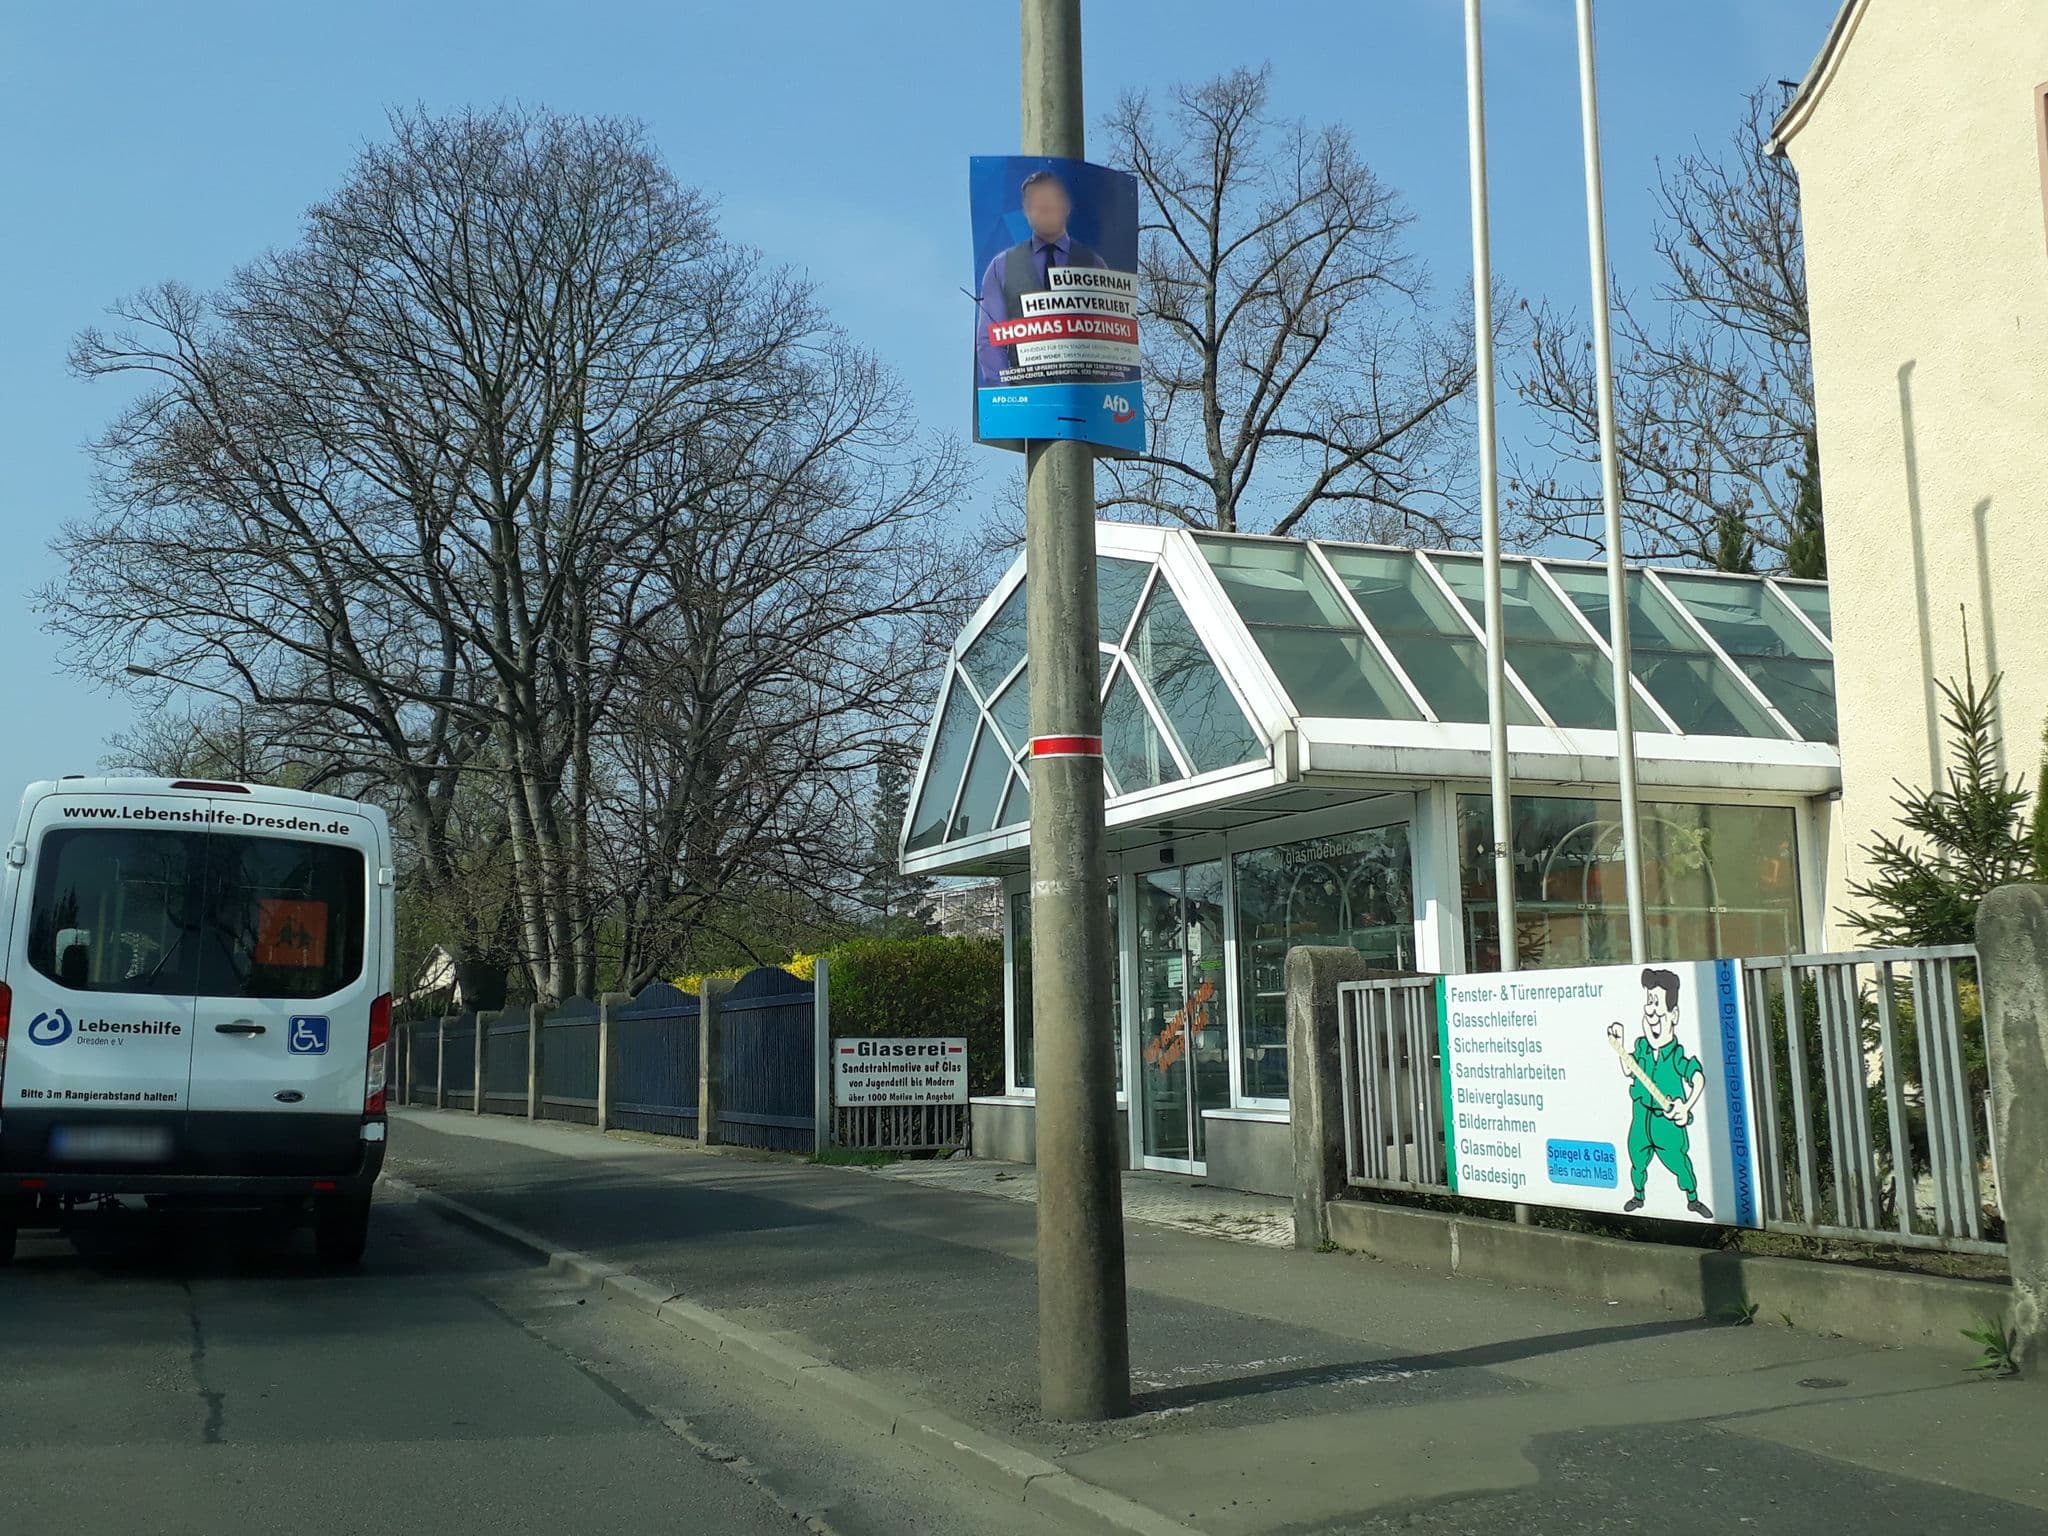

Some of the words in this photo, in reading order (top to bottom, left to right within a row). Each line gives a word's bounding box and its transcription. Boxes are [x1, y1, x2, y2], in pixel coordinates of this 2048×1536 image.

[1053, 271, 1131, 292] BÜRGERNAH
[1026, 296, 1130, 314] HEIMATVERLIEBT
[992, 320, 1064, 341] THOMAS
[1067, 321, 1131, 337] LADZINSKI
[1103, 394, 1129, 413] AfD
[63, 806, 350, 836] www.Lebenshilfe-Dresden.de
[1451, 986, 1497, 1003] Fenster-
[1500, 985, 1509, 1001] &
[1510, 982, 1604, 1003] Türenreparatur
[78, 1019, 181, 1035] Lebenshilfe
[1452, 1010, 1537, 1028] Glasschleiferei
[77, 1036, 109, 1045] Dresden
[858, 1041, 946, 1056] Glaserei
[1454, 1037, 1543, 1057] Sicherheitsglas
[842, 1061, 921, 1074] Sandstrahlmotive
[924, 1061, 940, 1073] auf
[942, 1061, 962, 1073] Glas
[1455, 1062, 1566, 1080] Sandstrahlarbeiten
[849, 1079, 863, 1088] von
[865, 1077, 908, 1090] Jugendstil
[911, 1077, 923, 1087] bis
[925, 1077, 955, 1086] Modern
[1719, 966, 1750, 1215] www.glaserei-herzig.de
[21, 1089, 43, 1099] Bitte
[65, 1090, 141, 1102] Rangierabstand
[143, 1091, 178, 1102] halten!
[849, 1093, 865, 1102] über
[868, 1093, 887, 1101] 1000
[889, 1093, 913, 1101] Motive
[915, 1092, 925, 1101] im
[926, 1092, 955, 1103] Angebot
[1457, 1087, 1544, 1111] Bleiverglasung
[1459, 1113, 1537, 1133] Bilderrahmen
[1460, 1138, 1521, 1159] Glasmöbel
[1547, 1145, 1582, 1163] Spiegel
[1584, 1148, 1591, 1161] &
[1593, 1149, 1615, 1163] Glas
[1462, 1163, 1527, 1190] Glasdesign
[1548, 1164, 1569, 1177] alles
[1570, 1167, 1592, 1179] nach
[1593, 1167, 1615, 1181] Maß
